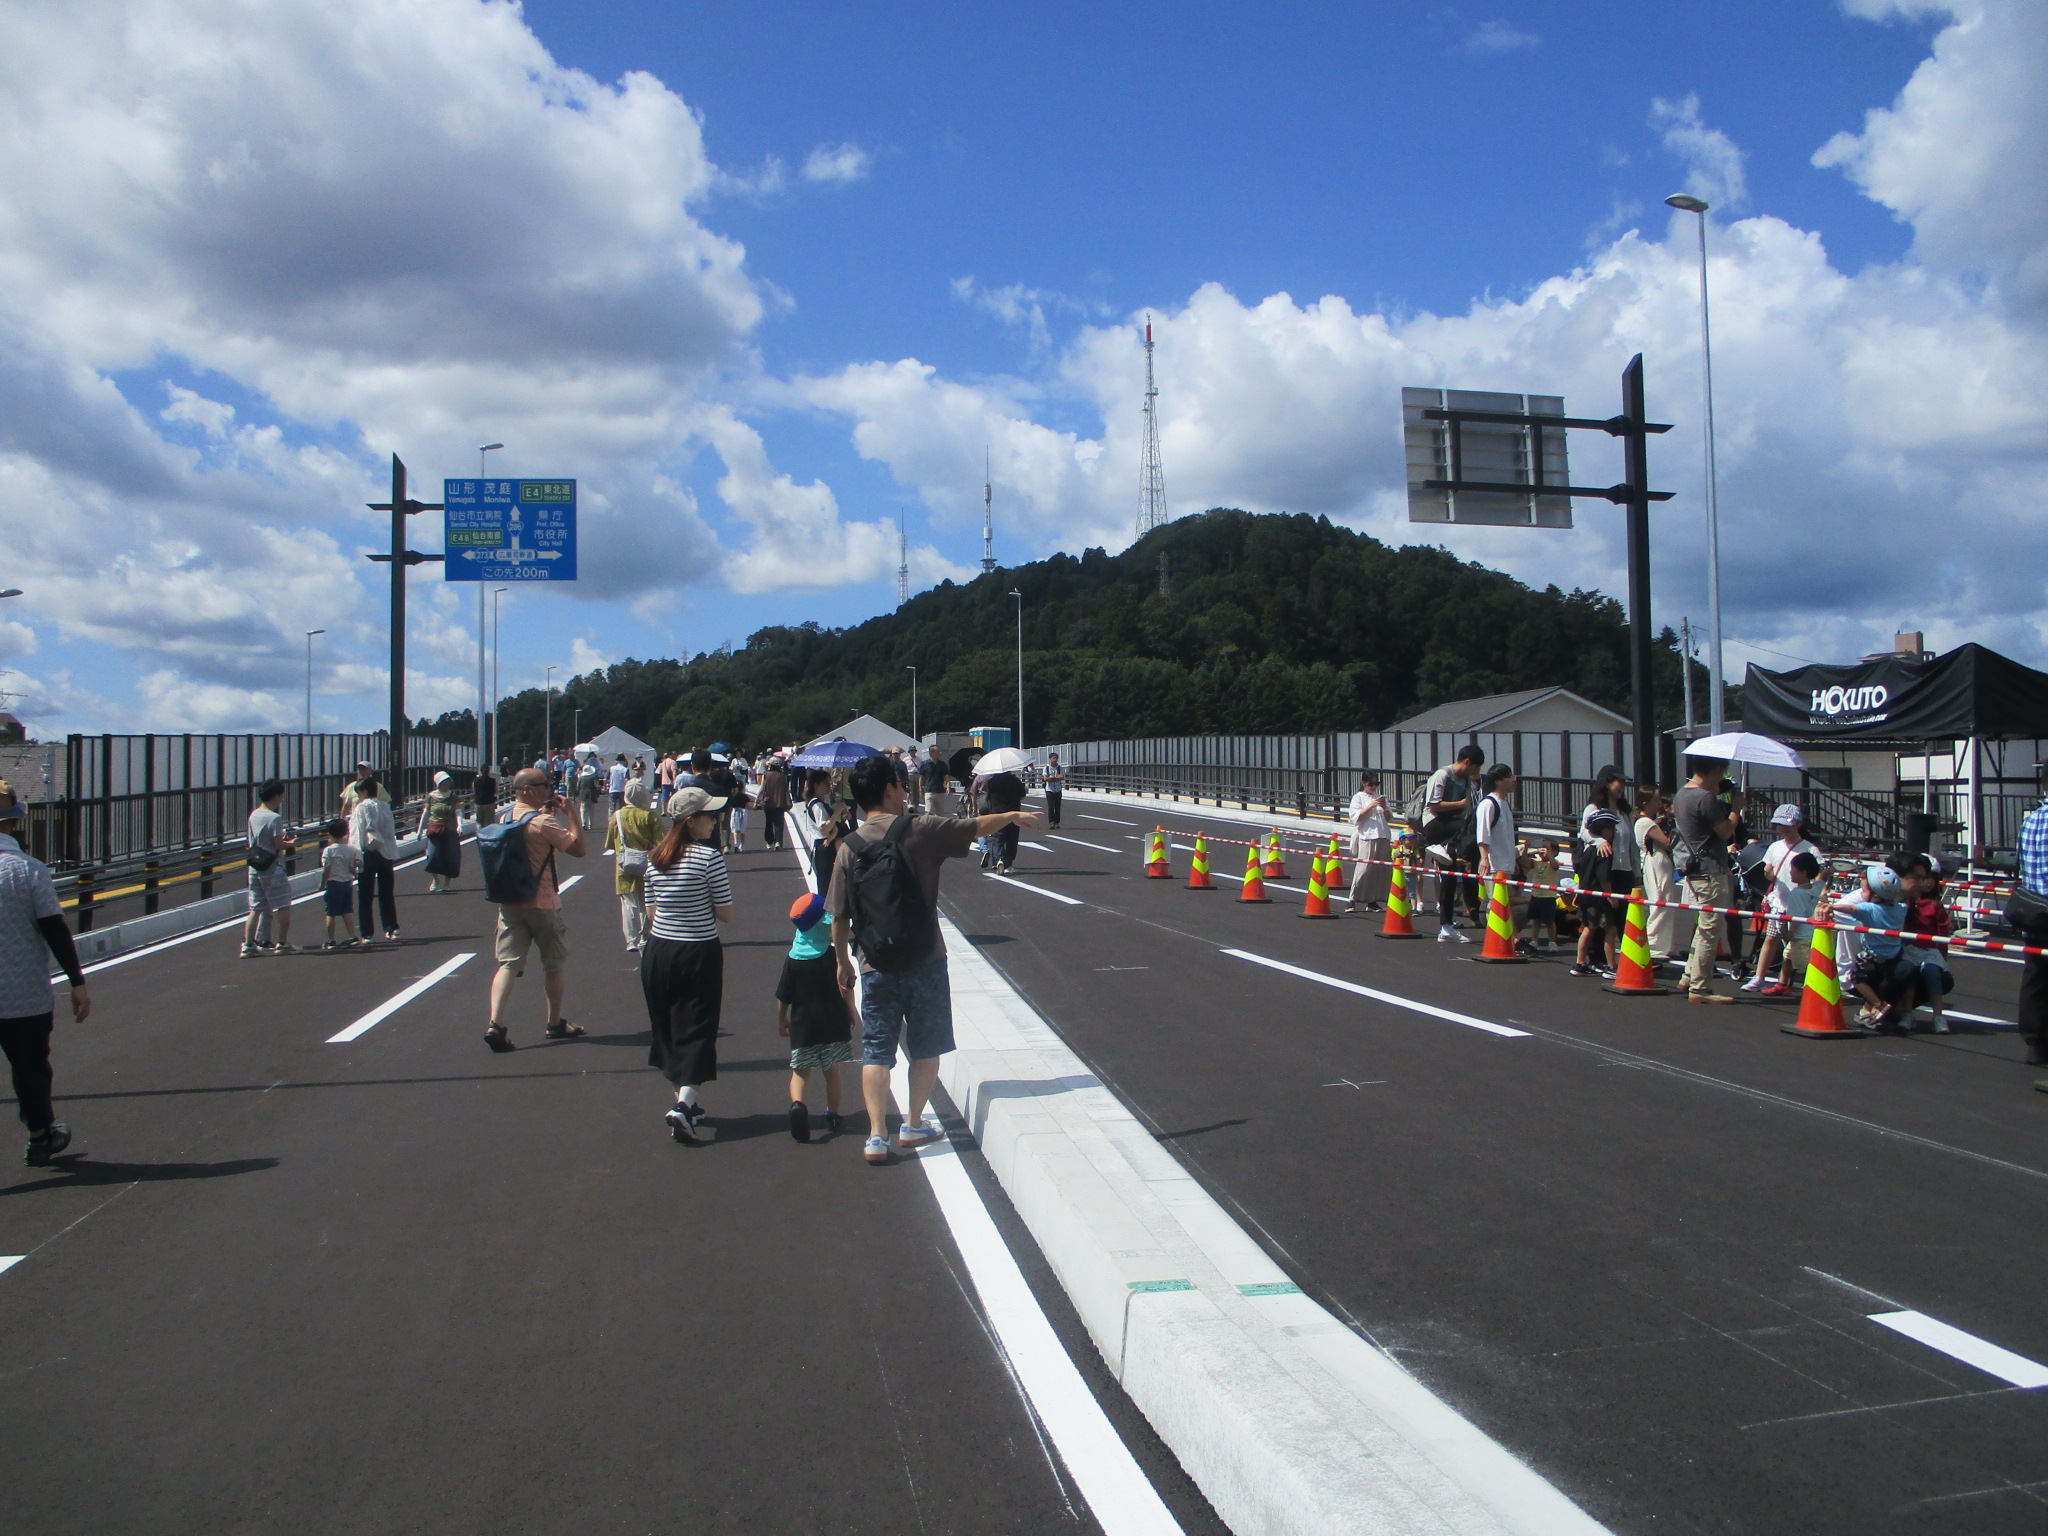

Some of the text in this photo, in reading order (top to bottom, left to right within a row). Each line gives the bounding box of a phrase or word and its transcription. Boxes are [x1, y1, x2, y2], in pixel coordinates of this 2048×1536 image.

[448, 482, 476, 495] 山形
[525, 487, 539, 497] E4
[1810, 685, 1888, 715] HOKUTO
